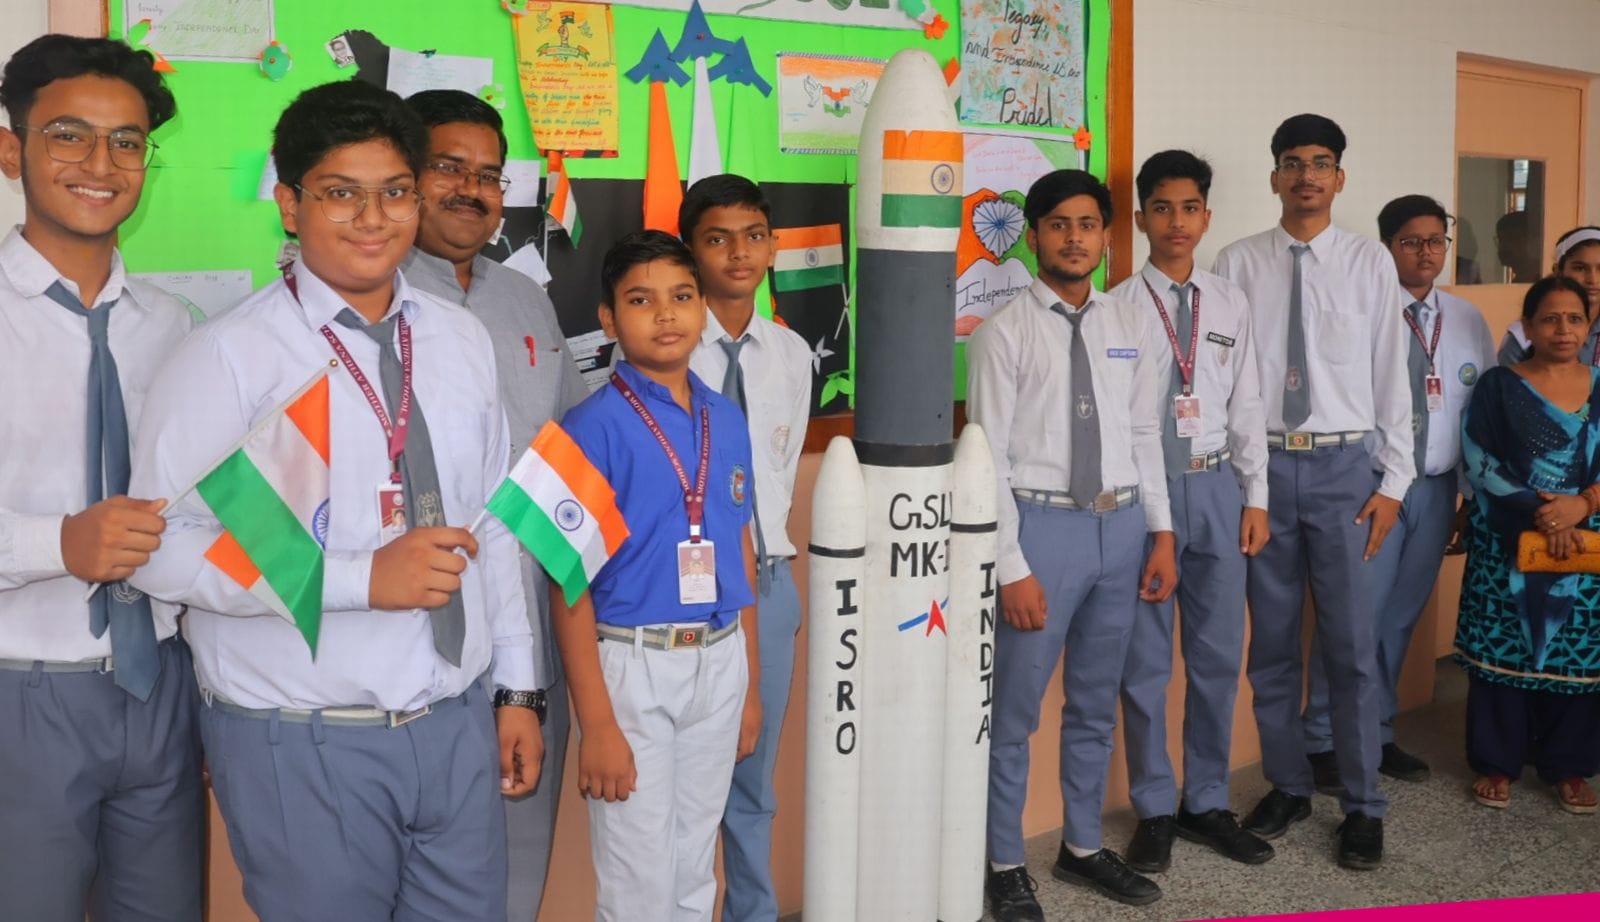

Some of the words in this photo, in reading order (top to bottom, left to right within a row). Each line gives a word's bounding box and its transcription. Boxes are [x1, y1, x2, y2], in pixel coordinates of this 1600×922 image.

[320, 324, 337, 344] SCH
[335, 344, 364, 384] ATHENA
[362, 384, 389, 427] MOTHER
[628, 395, 655, 427] MOTHER
[650, 425, 675, 458] ATHENA
[672, 458, 690, 492] SCHOOL
[697, 458, 706, 495] MOTHER
[889, 491, 951, 530] GSL
[836, 578, 858, 755] ISRO
[976, 561, 996, 745] INDIA
